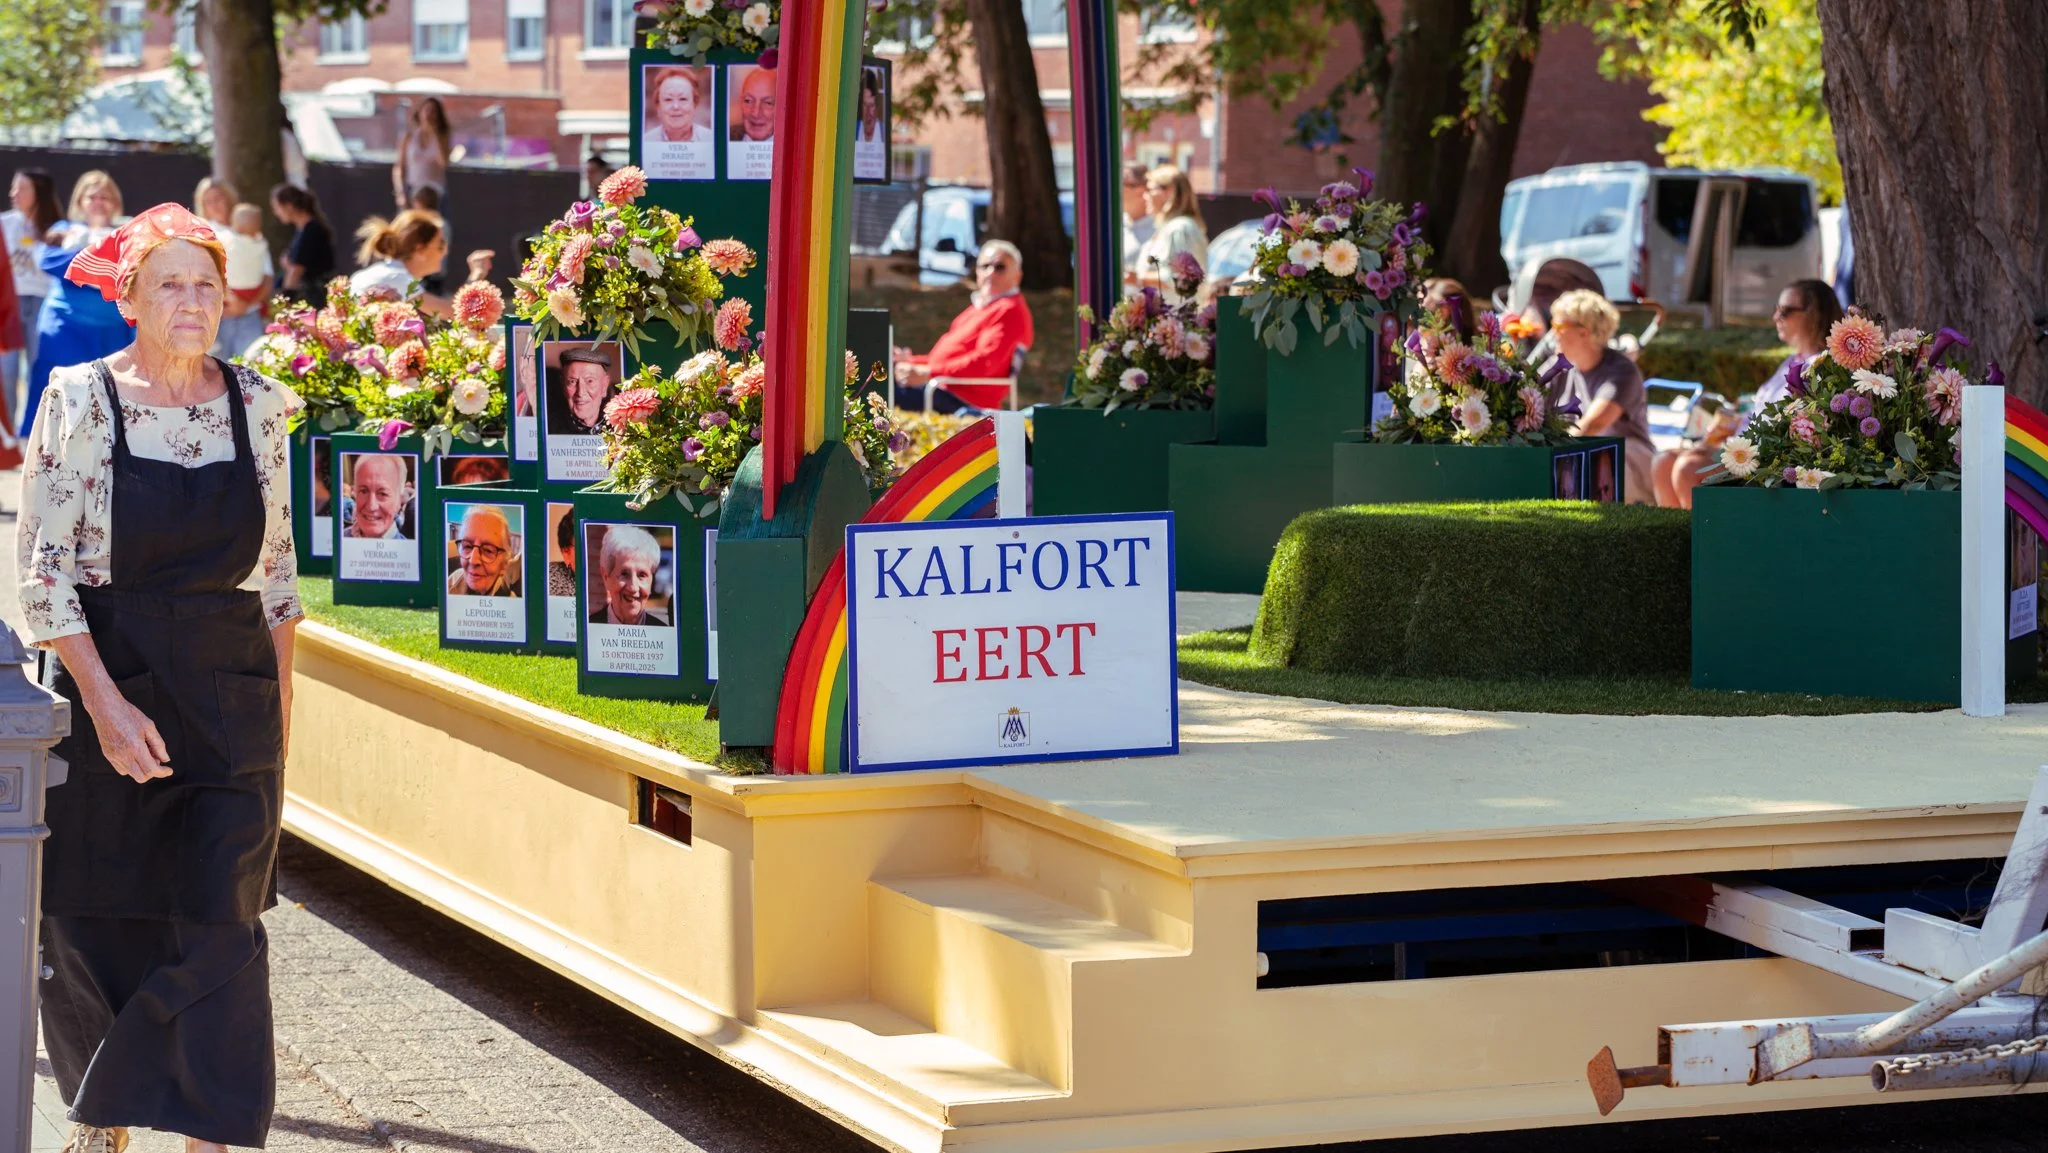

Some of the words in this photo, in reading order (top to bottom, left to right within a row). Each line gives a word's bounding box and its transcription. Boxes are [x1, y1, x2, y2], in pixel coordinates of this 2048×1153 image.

[571, 438, 602, 447] ALFONS
[376, 541, 384, 550] JO
[363, 550, 398, 559] VERRAES
[359, 560, 396, 568] SEPTEMBER
[873, 537, 1150, 599] KALFORT
[479, 599, 493, 608] ELS
[465, 609, 506, 619] LEPOUDRE
[462, 620, 498, 628] NOVEMBER
[618, 628, 647, 638] MARIA
[601, 638, 618, 647] VAN
[621, 639, 664, 649] BREEDAM
[611, 651, 645, 660] OKTOBER
[932, 622, 1096, 684] EERT
